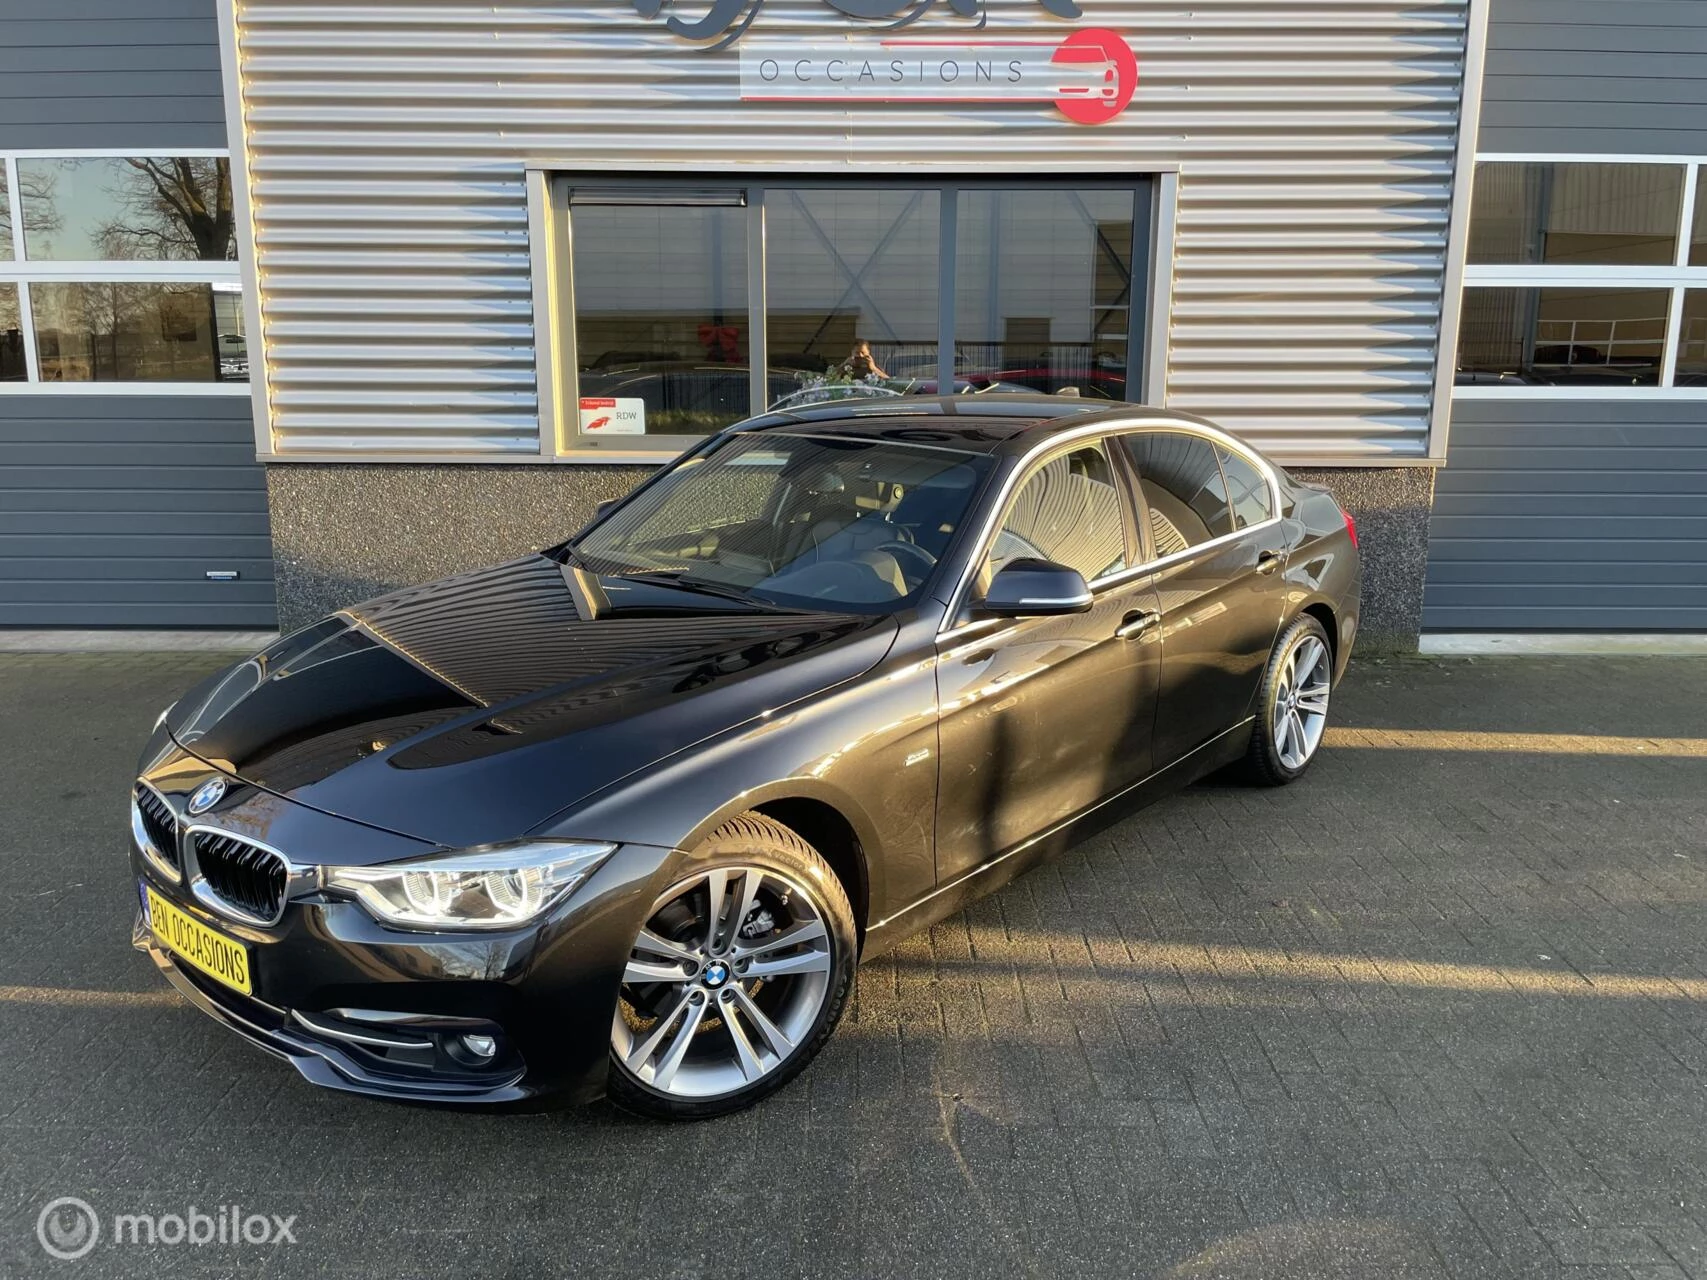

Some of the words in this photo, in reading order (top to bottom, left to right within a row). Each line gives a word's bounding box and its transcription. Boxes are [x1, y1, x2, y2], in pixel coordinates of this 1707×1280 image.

[758, 58, 1025, 84] OCCASIONS
[615, 411, 637, 420] RDW
[150, 895, 170, 940] BEN
[172, 912, 245, 985] OCCASIONS
